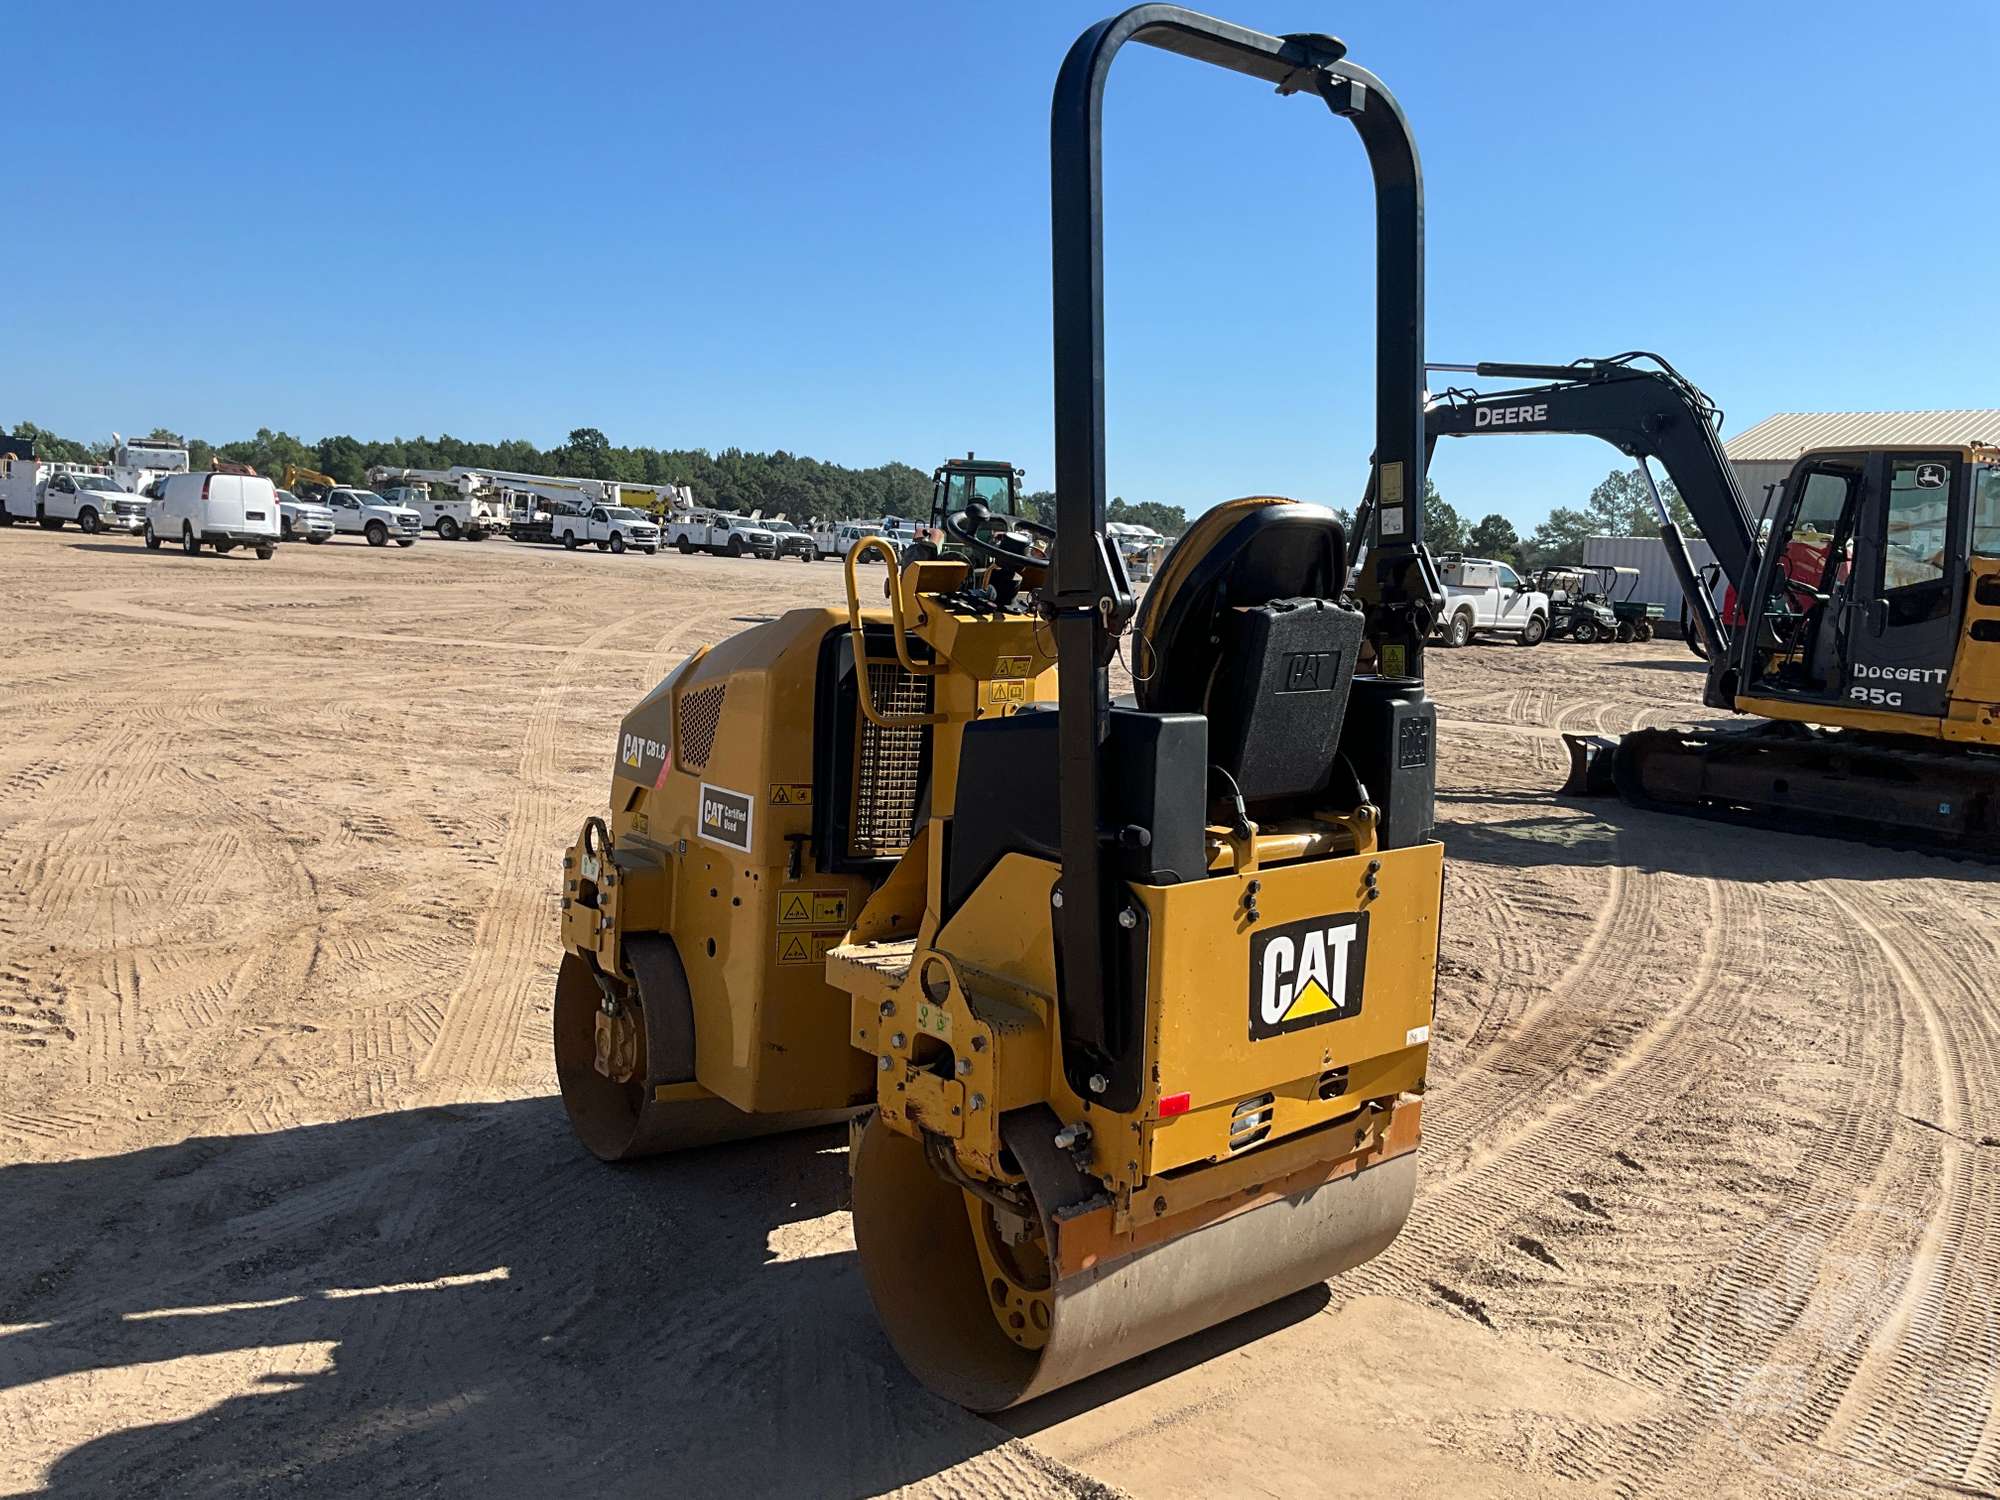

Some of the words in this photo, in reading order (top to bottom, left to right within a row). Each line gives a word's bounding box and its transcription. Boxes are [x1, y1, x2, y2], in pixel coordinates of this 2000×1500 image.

[1475, 404, 1547, 427] DEERE
[1853, 663, 1947, 684] DOGGETT
[1850, 686, 1902, 706] 85G
[622, 733, 645, 768] CAT
[646, 740, 666, 760] CB1.8
[704, 799, 724, 828] CAT
[724, 806, 747, 822] Certified
[723, 818, 737, 832] Used
[1260, 923, 1357, 1025] CAT
